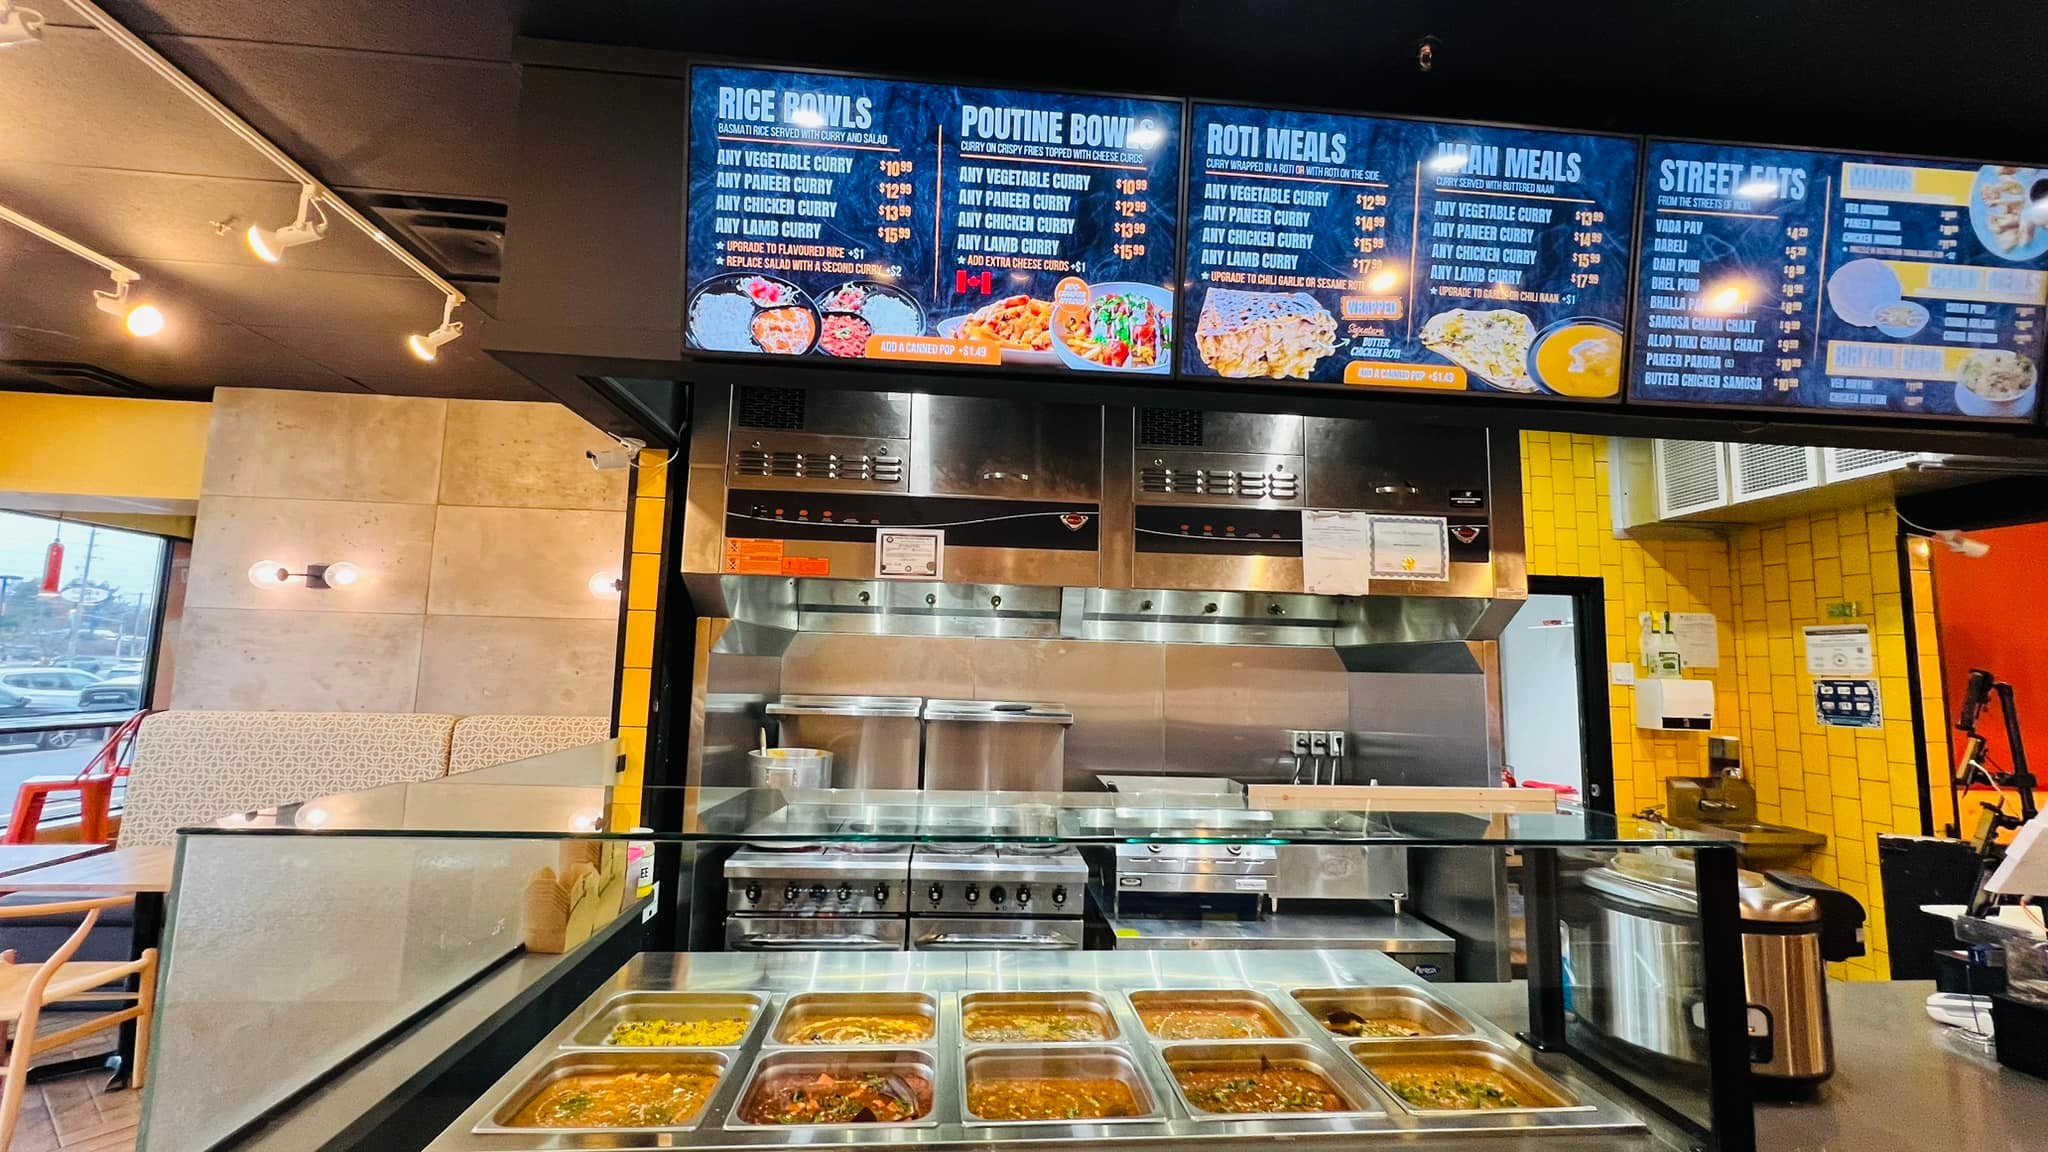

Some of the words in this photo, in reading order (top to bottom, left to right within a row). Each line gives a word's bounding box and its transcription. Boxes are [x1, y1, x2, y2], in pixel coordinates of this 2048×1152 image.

[718, 87, 775, 123] RICE
[783, 91, 872, 129] BOWLS
[718, 123, 751, 135] BASMATI
[753, 125, 770, 137] RICE
[770, 127, 800, 139] SERVED
[801, 129, 819, 140] WITH
[821, 130, 845, 142] CURRY
[847, 132, 862, 143] AND
[863, 133, 887, 145] SALAD
[961, 105, 1063, 143] POUTINE
[1070, 112, 1154, 150] BOWLS
[960, 141, 985, 153] CURRY
[986, 143, 997, 153] ON
[997, 143, 1023, 155] CRISPY
[1024, 145, 1044, 156] FRIES
[1045, 147, 1072, 158] TOPPED
[1073, 149, 1092, 160] WITH
[1092, 150, 1119, 161] CHEESE
[1120, 152, 1143, 163] CURDS
[1207, 123, 1259, 158] ROTI
[1266, 128, 1347, 164] MEALS
[717, 149, 742, 166] ANY
[744, 151, 810, 171] VEGETABLE
[813, 156, 853, 173] CURRY
[1206, 160, 1229, 170] CURRY
[1230, 161, 1264, 172] WRAPPED
[1264, 164, 1272, 173] IN
[1273, 164, 1278, 173] A
[1279, 165, 1294, 174] ROTI
[1295, 166, 1304, 175] OR
[1306, 166, 1323, 176] WITH
[1324, 167, 1339, 178] ROTI
[1340, 168, 1350, 178] ON
[1351, 169, 1364, 179] THE
[1365, 170, 1380, 180] SIDE
[1504, 148, 1581, 183] MEALS
[716, 172, 740, 189] ANY
[744, 174, 790, 192] PANEER
[793, 177, 833, 195] CURRY
[959, 166, 983, 184] ANY
[986, 168, 1050, 188] VEGETABLE
[1052, 173, 1091, 191] CURRY
[1436, 177, 1458, 187] CURRY
[1459, 178, 1484, 189] SERVED
[1485, 180, 1501, 190] WITH
[1502, 181, 1535, 193] BUTTERED
[1536, 184, 1555, 194] NAAN
[1659, 159, 1744, 196] STREET
[1751, 165, 1807, 200] EATS
[958, 189, 982, 206] ANY
[985, 191, 1030, 209] PANEER
[1033, 194, 1071, 211] CURRY
[1204, 184, 1228, 200] ANY
[1230, 186, 1290, 204] VEGETABLE
[1292, 190, 1329, 207] CURRY
[715, 195, 740, 212] ANY
[743, 197, 795, 215] CHICKEN
[797, 200, 838, 218] CURRY
[1203, 206, 1226, 222] ANY
[1228, 207, 1271, 225] PANEER
[1273, 210, 1310, 227] CURRY
[1434, 201, 1457, 217] ANY
[1459, 203, 1516, 221] VEGETABLE
[1517, 207, 1553, 223] CURRY
[715, 218, 740, 234] ANY
[743, 219, 779, 237] LAMB
[781, 222, 821, 240] CURRY
[958, 212, 982, 229] ANY
[984, 213, 1034, 232] CHICKEN
[1037, 217, 1075, 235] CURRY
[1432, 222, 1455, 238] ANY
[1457, 224, 1497, 241] PANEER
[1499, 227, 1535, 243] CURRY
[1656, 219, 1682, 233] VADA
[1683, 221, 1703, 235] PAV
[957, 234, 982, 251] ANY
[983, 236, 1018, 253] LAMB
[1021, 238, 1059, 256] CURRY
[1202, 228, 1225, 244] ANY
[1227, 229, 1275, 247] CHICKEN
[1277, 232, 1314, 249] CURRY
[1654, 238, 1687, 253] DABELI
[727, 241, 764, 254] UPGRADE
[765, 243, 776, 254] TO
[778, 244, 825, 257] FLAVOURED
[826, 247, 845, 258] RICE
[847, 248, 864, 259] +$1
[1201, 249, 1224, 266] ANY
[1226, 251, 1259, 268] LAMB
[1262, 253, 1299, 270] CURRY
[1431, 244, 1454, 259] ANY
[1456, 245, 1500, 262] CHICKEN
[1502, 248, 1538, 264] CURRY
[726, 258, 763, 269] REPLACE
[764, 259, 790, 271] SALAD
[792, 261, 813, 272] WITH
[814, 262, 820, 272] A
[822, 262, 854, 274] SECOND
[855, 264, 882, 276] CURRY
[886, 265, 902, 277] +$2
[967, 255, 984, 266] ADD
[985, 256, 1011, 268] EXTRA
[1011, 258, 1042, 270] CHEESE
[1043, 260, 1069, 271] CURDS
[1070, 261, 1086, 272] +$1
[1652, 257, 1676, 271] DAHI
[1678, 259, 1700, 272] PURI
[1211, 272, 1246, 283] UPGRADE
[1247, 274, 1257, 284] TO
[1258, 275, 1277, 285] CHILI
[1278, 276, 1304, 287] GARLIC
[1305, 278, 1316, 287] OR
[1317, 278, 1347, 289] SESAME
[1348, 280, 1365, 290] ROTI
[1430, 265, 1451, 281] ANY
[1453, 266, 1485, 283] LAMB
[1487, 269, 1522, 285] CURRY
[1651, 277, 1674, 291] BHEL
[1677, 278, 1700, 292] PURI
[1346, 300, 1396, 315] WRAPPED
[1650, 296, 1686, 310] BHALLA
[1648, 315, 1690, 330] SAMOSA
[1725, 319, 1757, 333] CHAAT
[880, 341, 897, 352] ADD
[898, 342, 904, 353] A
[905, 342, 935, 354] CANNED
[937, 344, 955, 355] POP
[1350, 346, 1382, 358] CHICKEN
[1384, 349, 1401, 359] ROTI
[1362, 338, 1390, 347] BUTTER
[1647, 334, 1672, 348] ALOO
[1674, 335, 1698, 349] TIKKI
[1700, 337, 1731, 351] CHANA
[1733, 338, 1764, 352] CHAAT
[1646, 353, 1682, 367] PANEER
[1684, 355, 1721, 369] PAKORA
[1645, 372, 1679, 386] BUTTER
[1681, 374, 1720, 388] CHICKEN
[1722, 376, 1763, 390] SAMOSA
